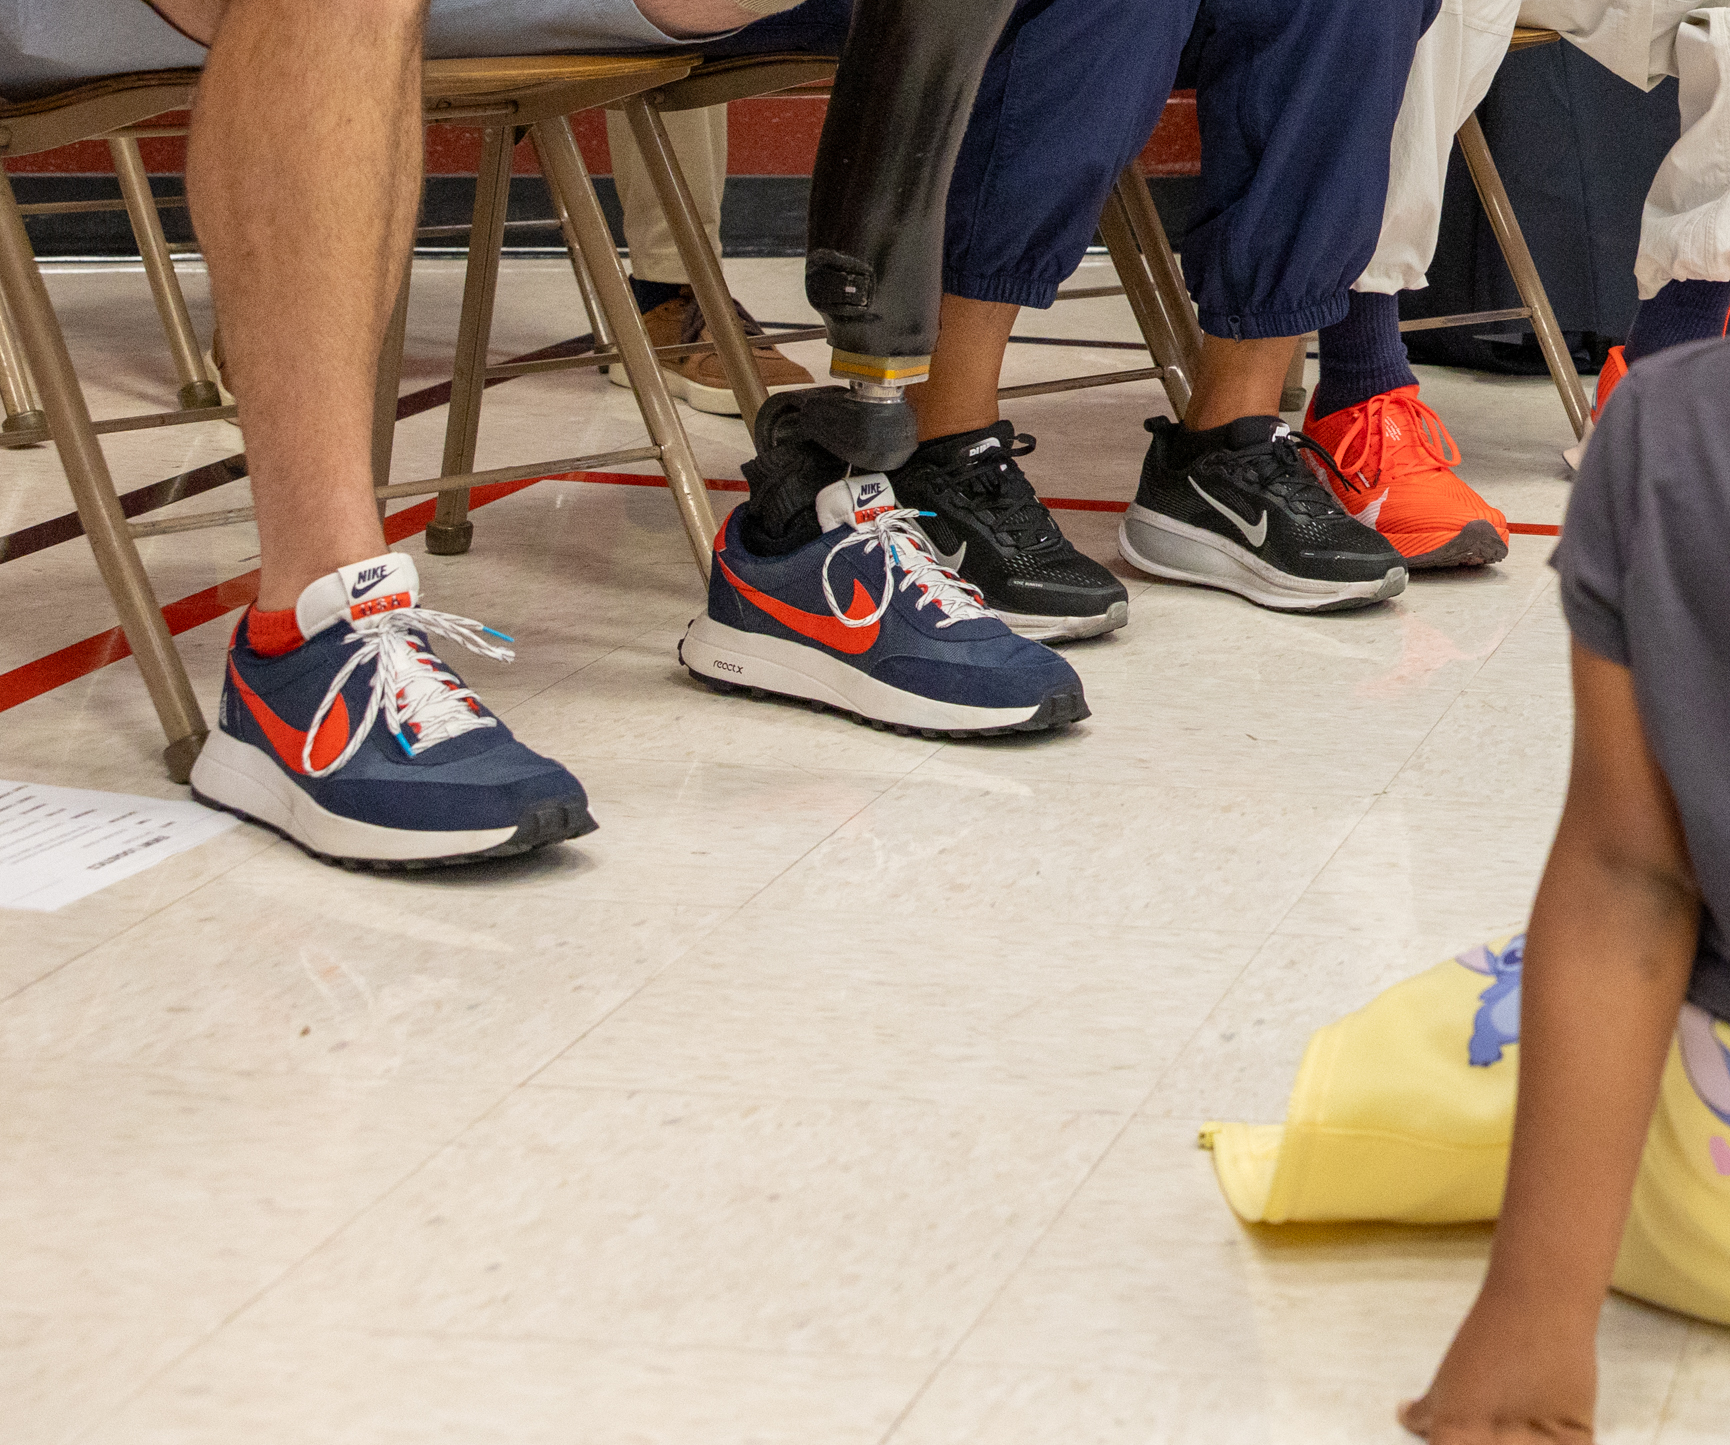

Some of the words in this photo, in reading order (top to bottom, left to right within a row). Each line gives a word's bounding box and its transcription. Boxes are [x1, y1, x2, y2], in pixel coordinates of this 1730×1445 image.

[861, 483, 881, 496] NIKE
[358, 564, 387, 584] NIKE
[360, 595, 401, 616] USA
